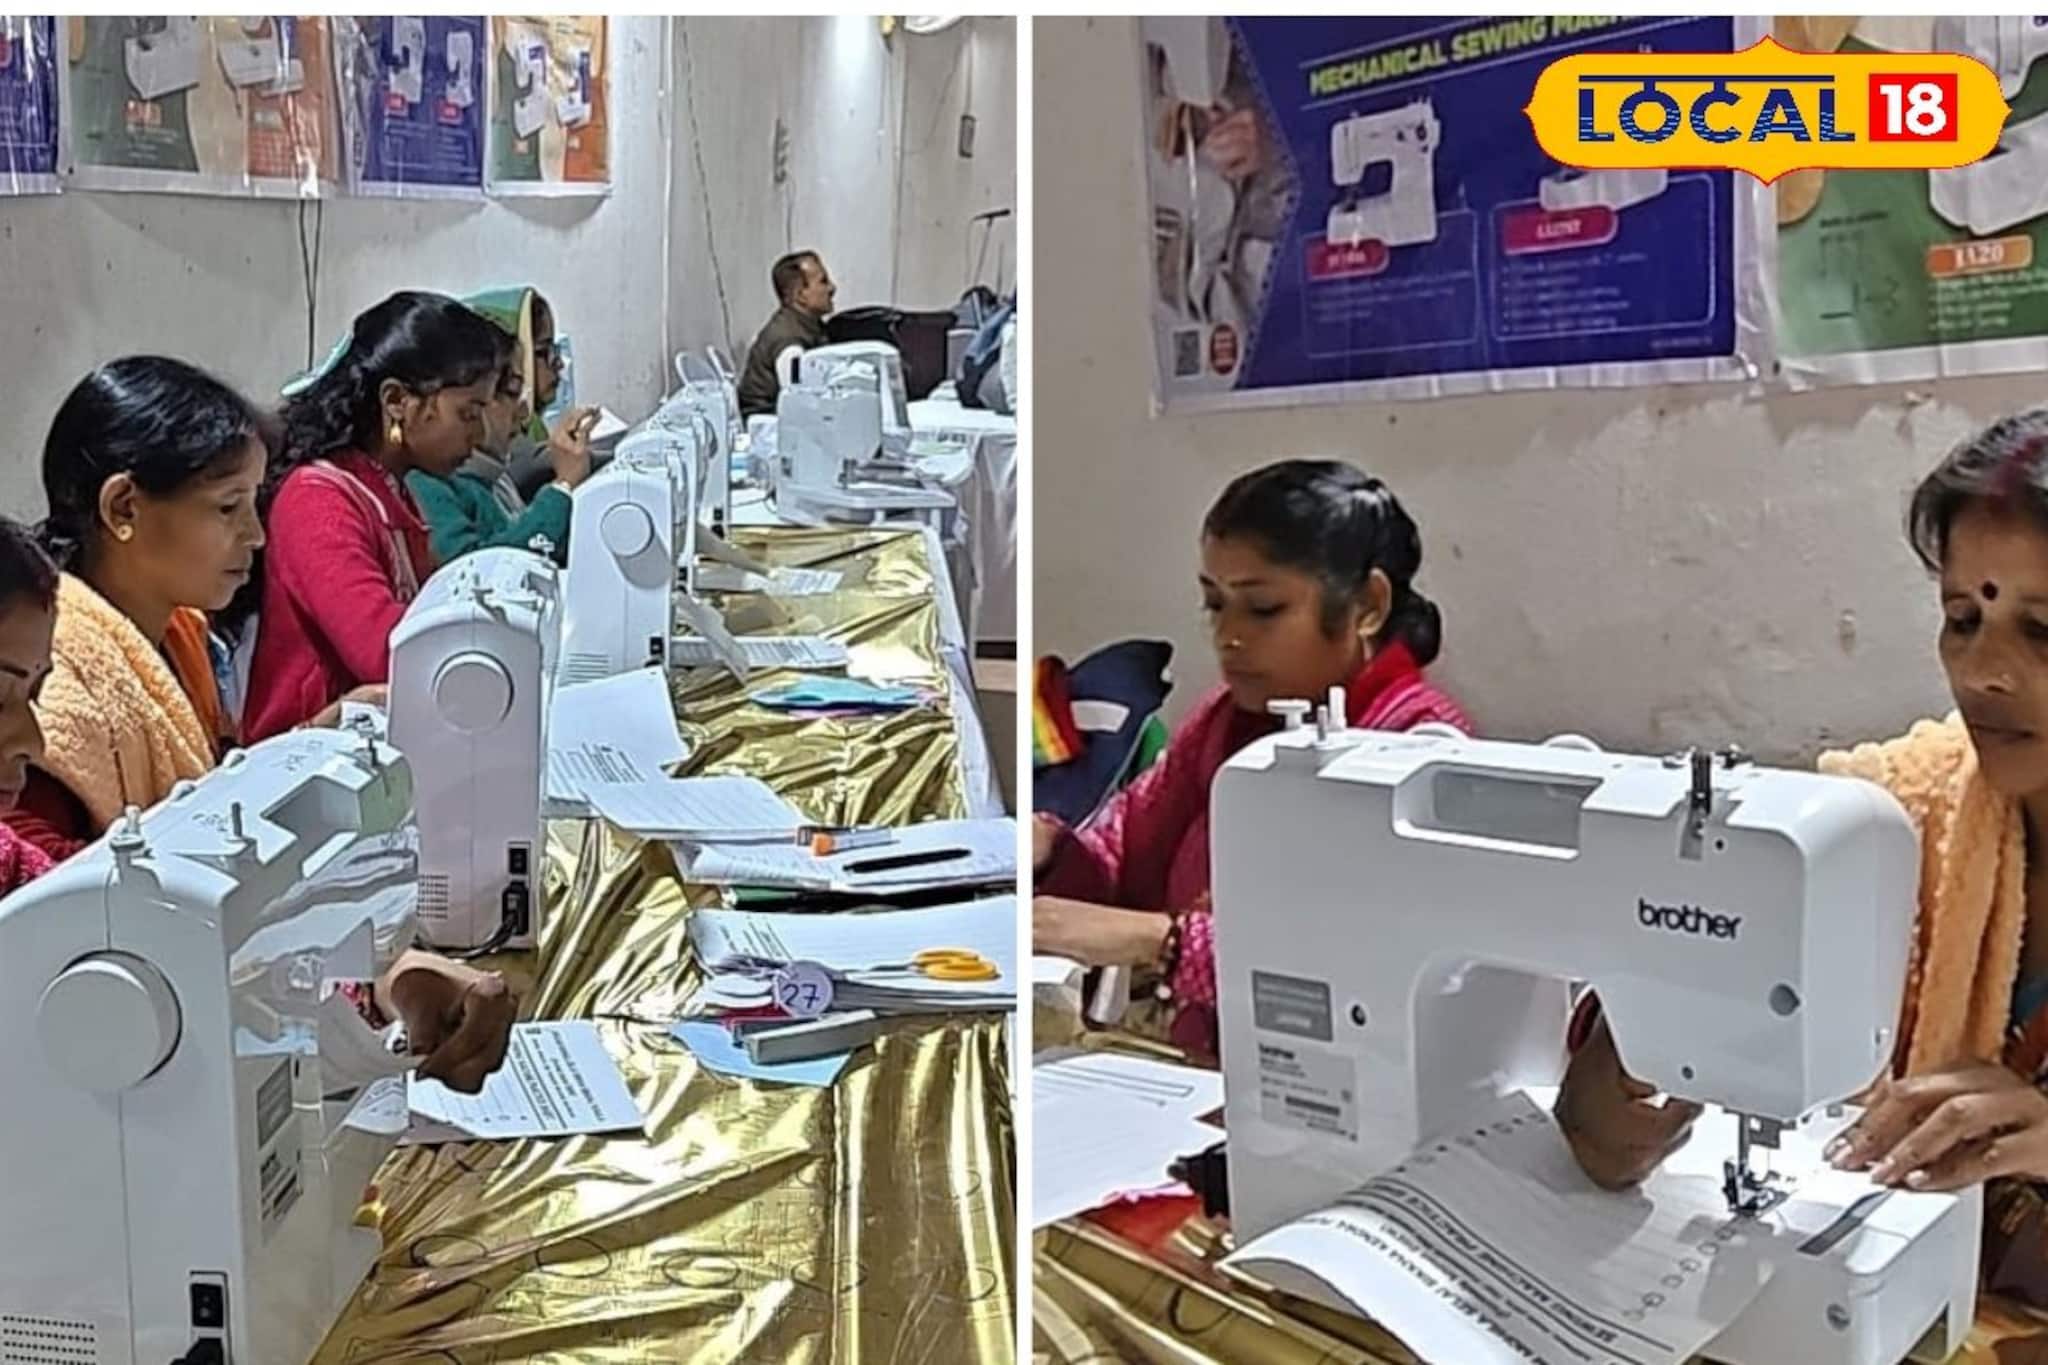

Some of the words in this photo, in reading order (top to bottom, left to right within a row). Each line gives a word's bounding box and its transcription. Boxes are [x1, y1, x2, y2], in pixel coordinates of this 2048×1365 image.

[1309, 39, 1448, 96] MECHANICAL
[1452, 17, 1546, 62] SEWING
[1637, 896, 1743, 940] brother
[782, 983, 821, 1009] 27
